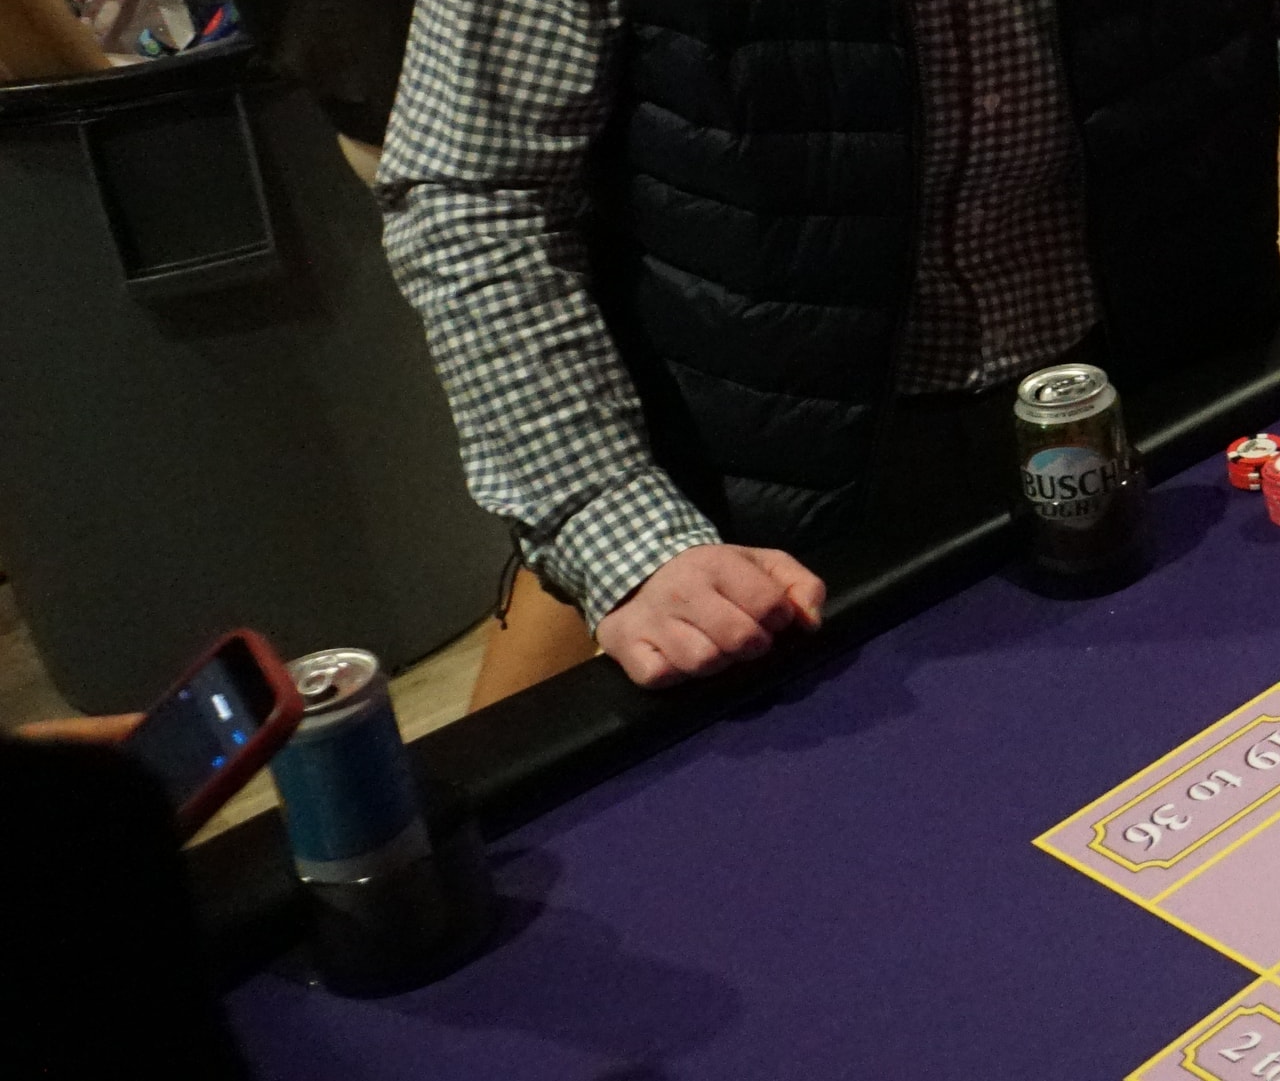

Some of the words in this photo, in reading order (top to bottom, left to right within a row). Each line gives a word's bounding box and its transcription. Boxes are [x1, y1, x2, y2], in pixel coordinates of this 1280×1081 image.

[1022, 462, 1117, 500] BUSCH
[1187, 768, 1242, 802] to
[1123, 803, 1192, 851] 36
[1218, 1031, 1263, 1063] 2
